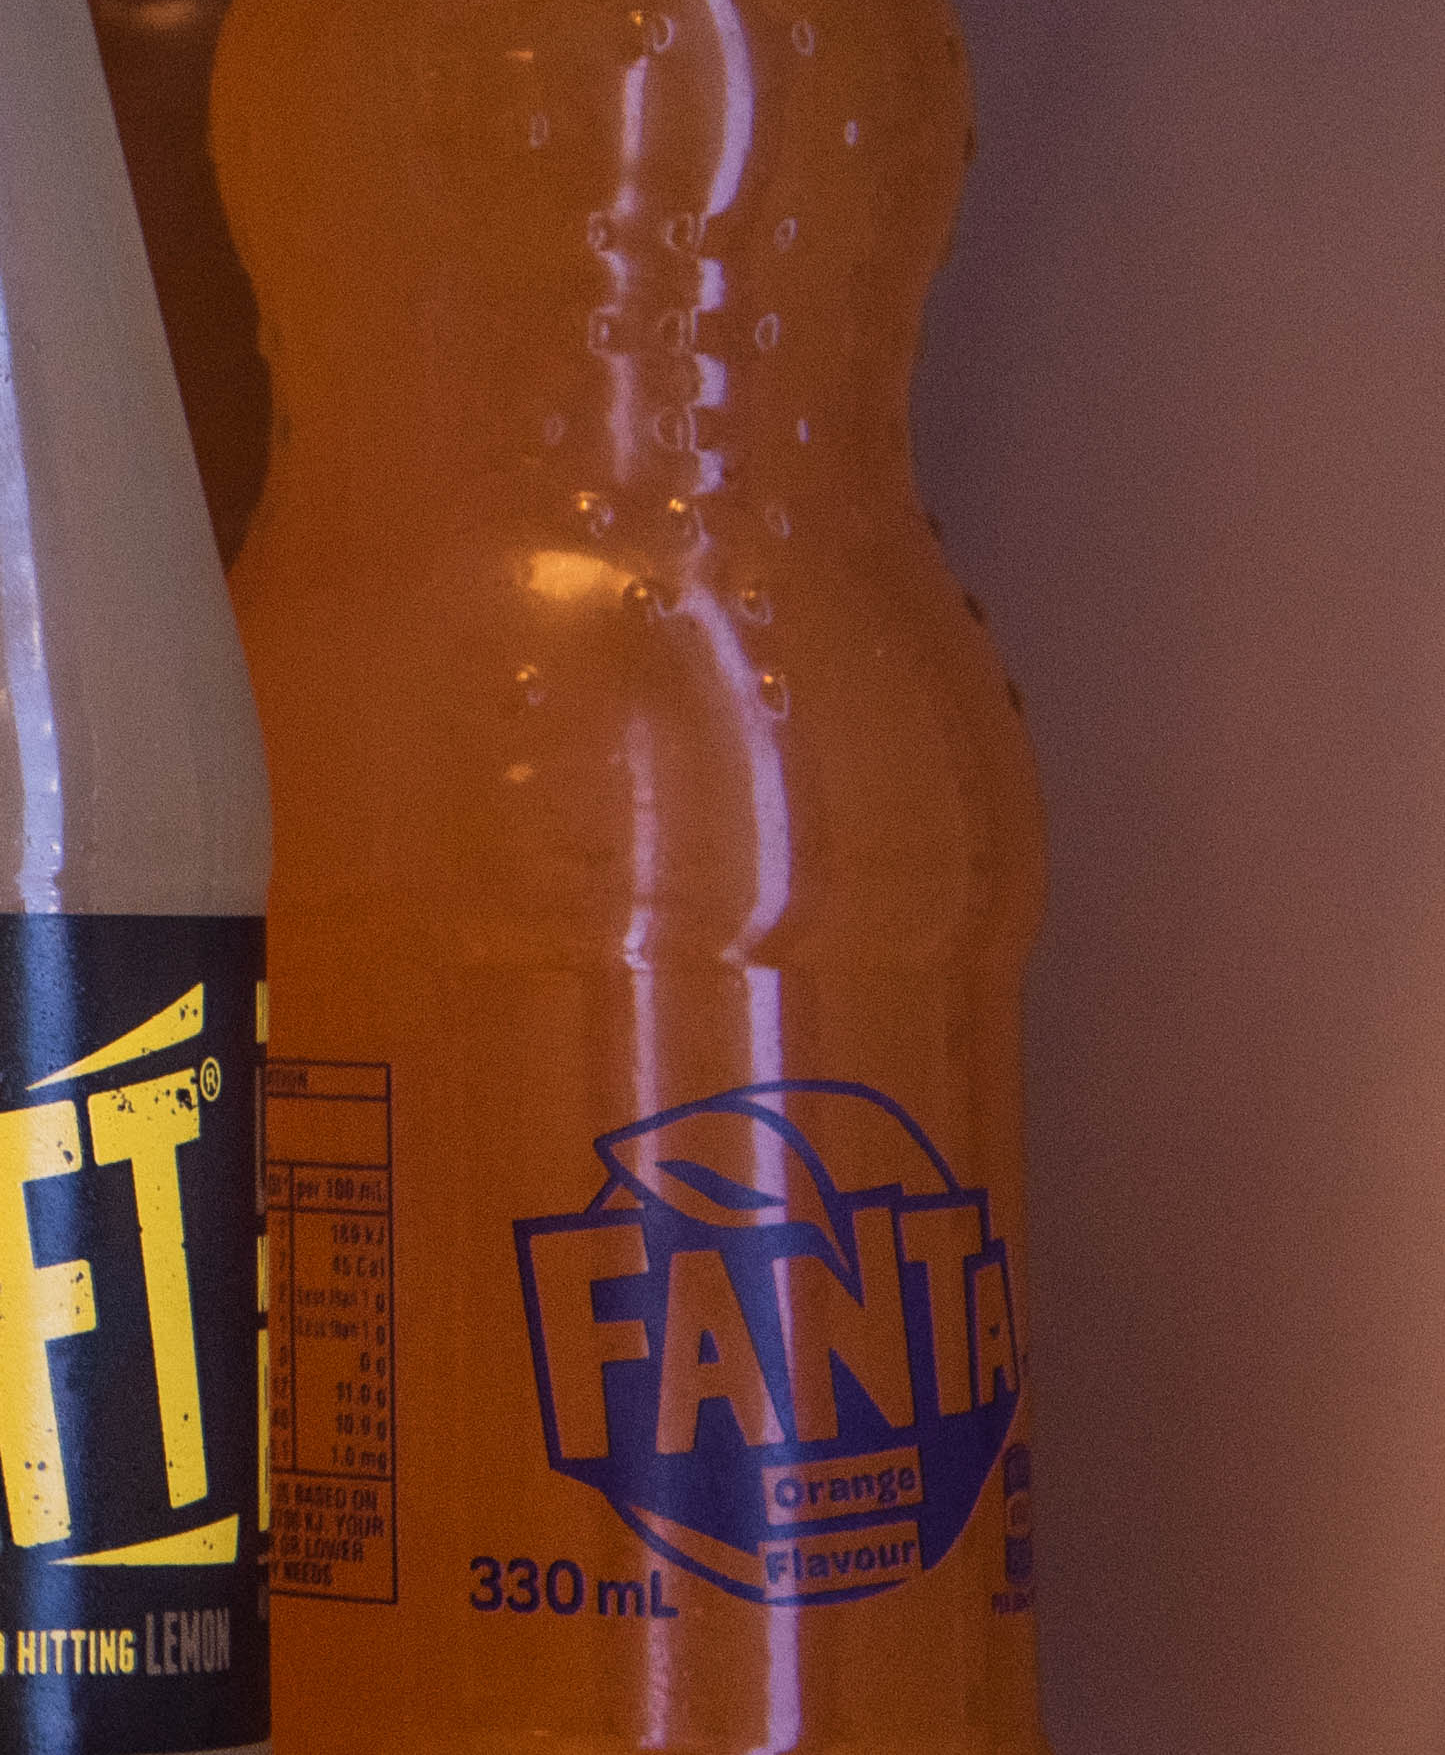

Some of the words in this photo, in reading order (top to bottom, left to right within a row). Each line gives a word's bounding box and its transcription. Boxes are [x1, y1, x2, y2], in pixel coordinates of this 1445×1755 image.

[524, 1197, 1019, 1463] FANTA
[773, 1466, 917, 1510] Orange
[335, 1515, 385, 1538] YOUR
[305, 1538, 364, 1563] LOWER
[765, 1539, 916, 1585] Flavour
[468, 1555, 584, 1616] 330
[596, 1569, 679, 1620] mL
[17, 1629, 135, 1676] HITTING
[144, 1609, 230, 1676] LEMON
